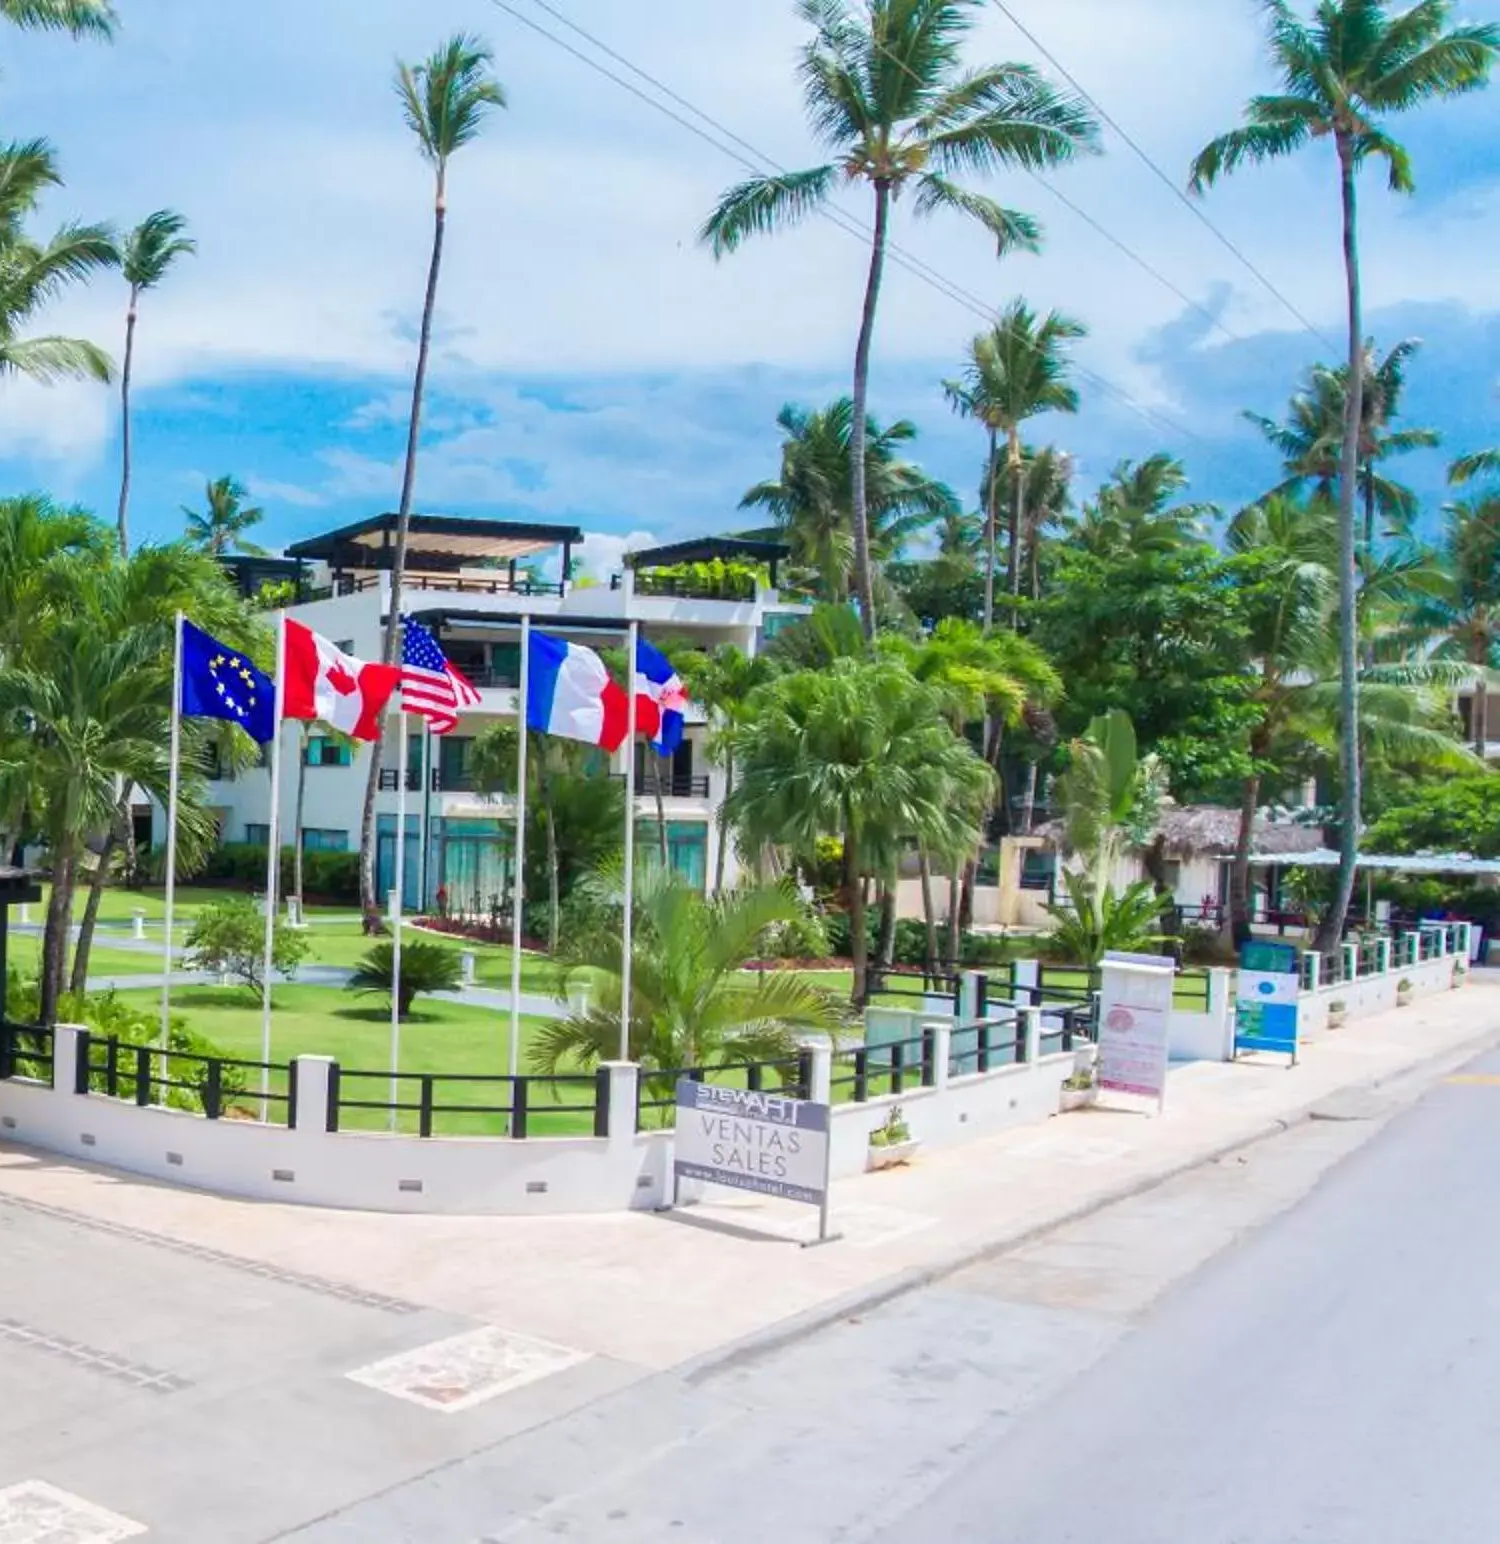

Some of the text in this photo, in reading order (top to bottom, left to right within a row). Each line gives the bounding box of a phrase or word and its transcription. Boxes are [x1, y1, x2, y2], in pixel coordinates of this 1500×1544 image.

[696, 1085, 805, 1125] STEWART
[702, 1115, 802, 1154] VENTAS
[711, 1143, 788, 1177] SALES
